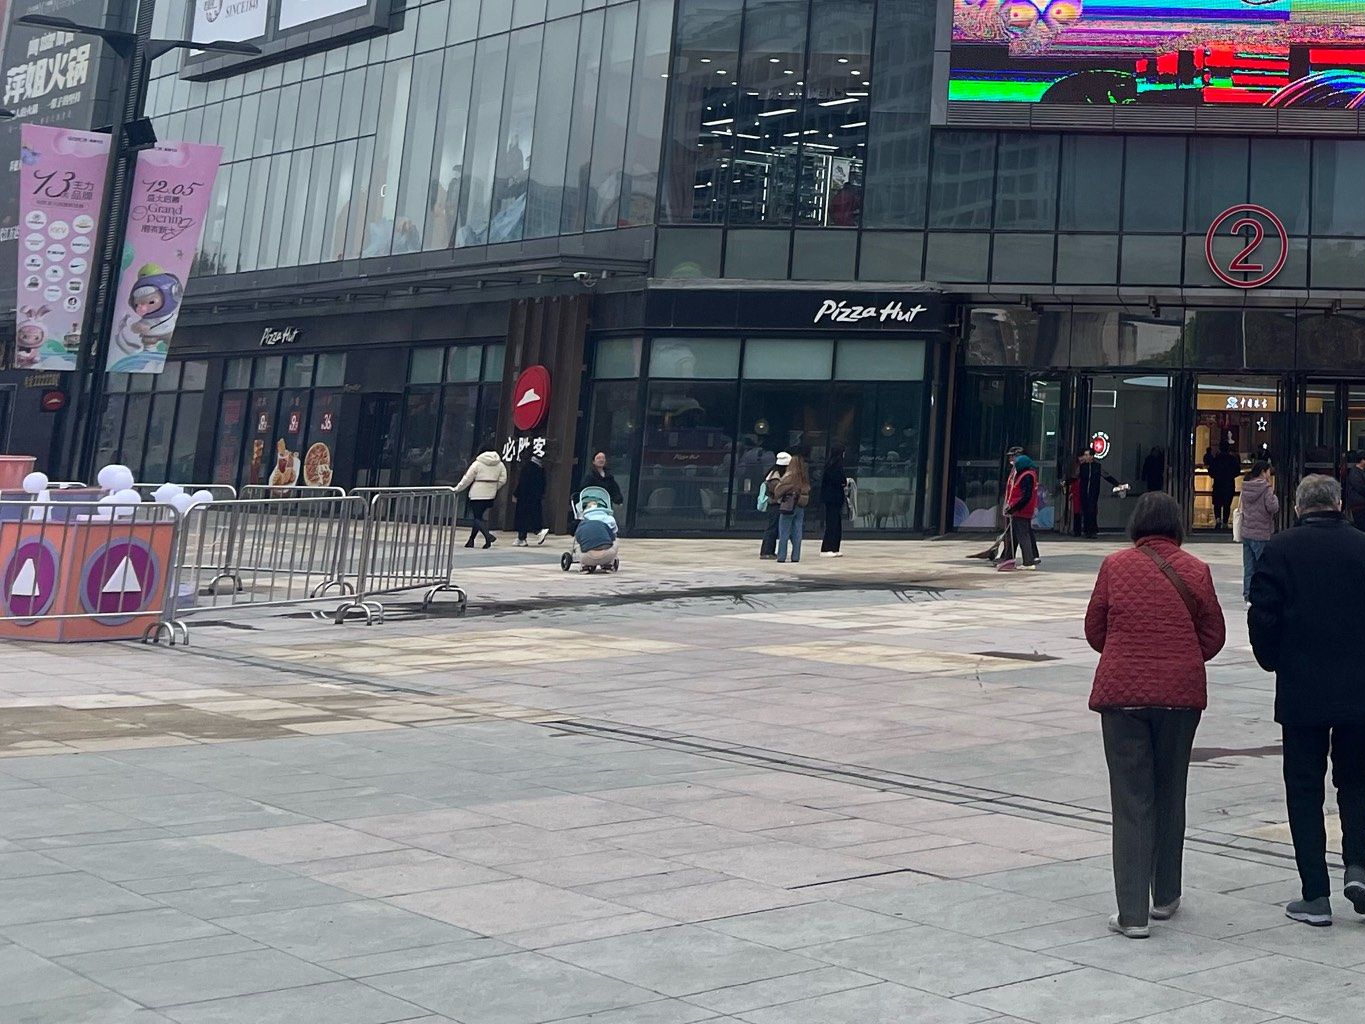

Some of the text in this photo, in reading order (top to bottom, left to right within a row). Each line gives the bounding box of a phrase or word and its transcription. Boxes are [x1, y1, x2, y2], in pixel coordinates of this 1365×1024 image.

[32, 169, 76, 198] 13
[142, 180, 205, 196] 12.05
[147, 203, 183, 215] Grand
[814, 299, 928, 323] Pizza Hut
[260, 327, 301, 346] Pizza Hut
